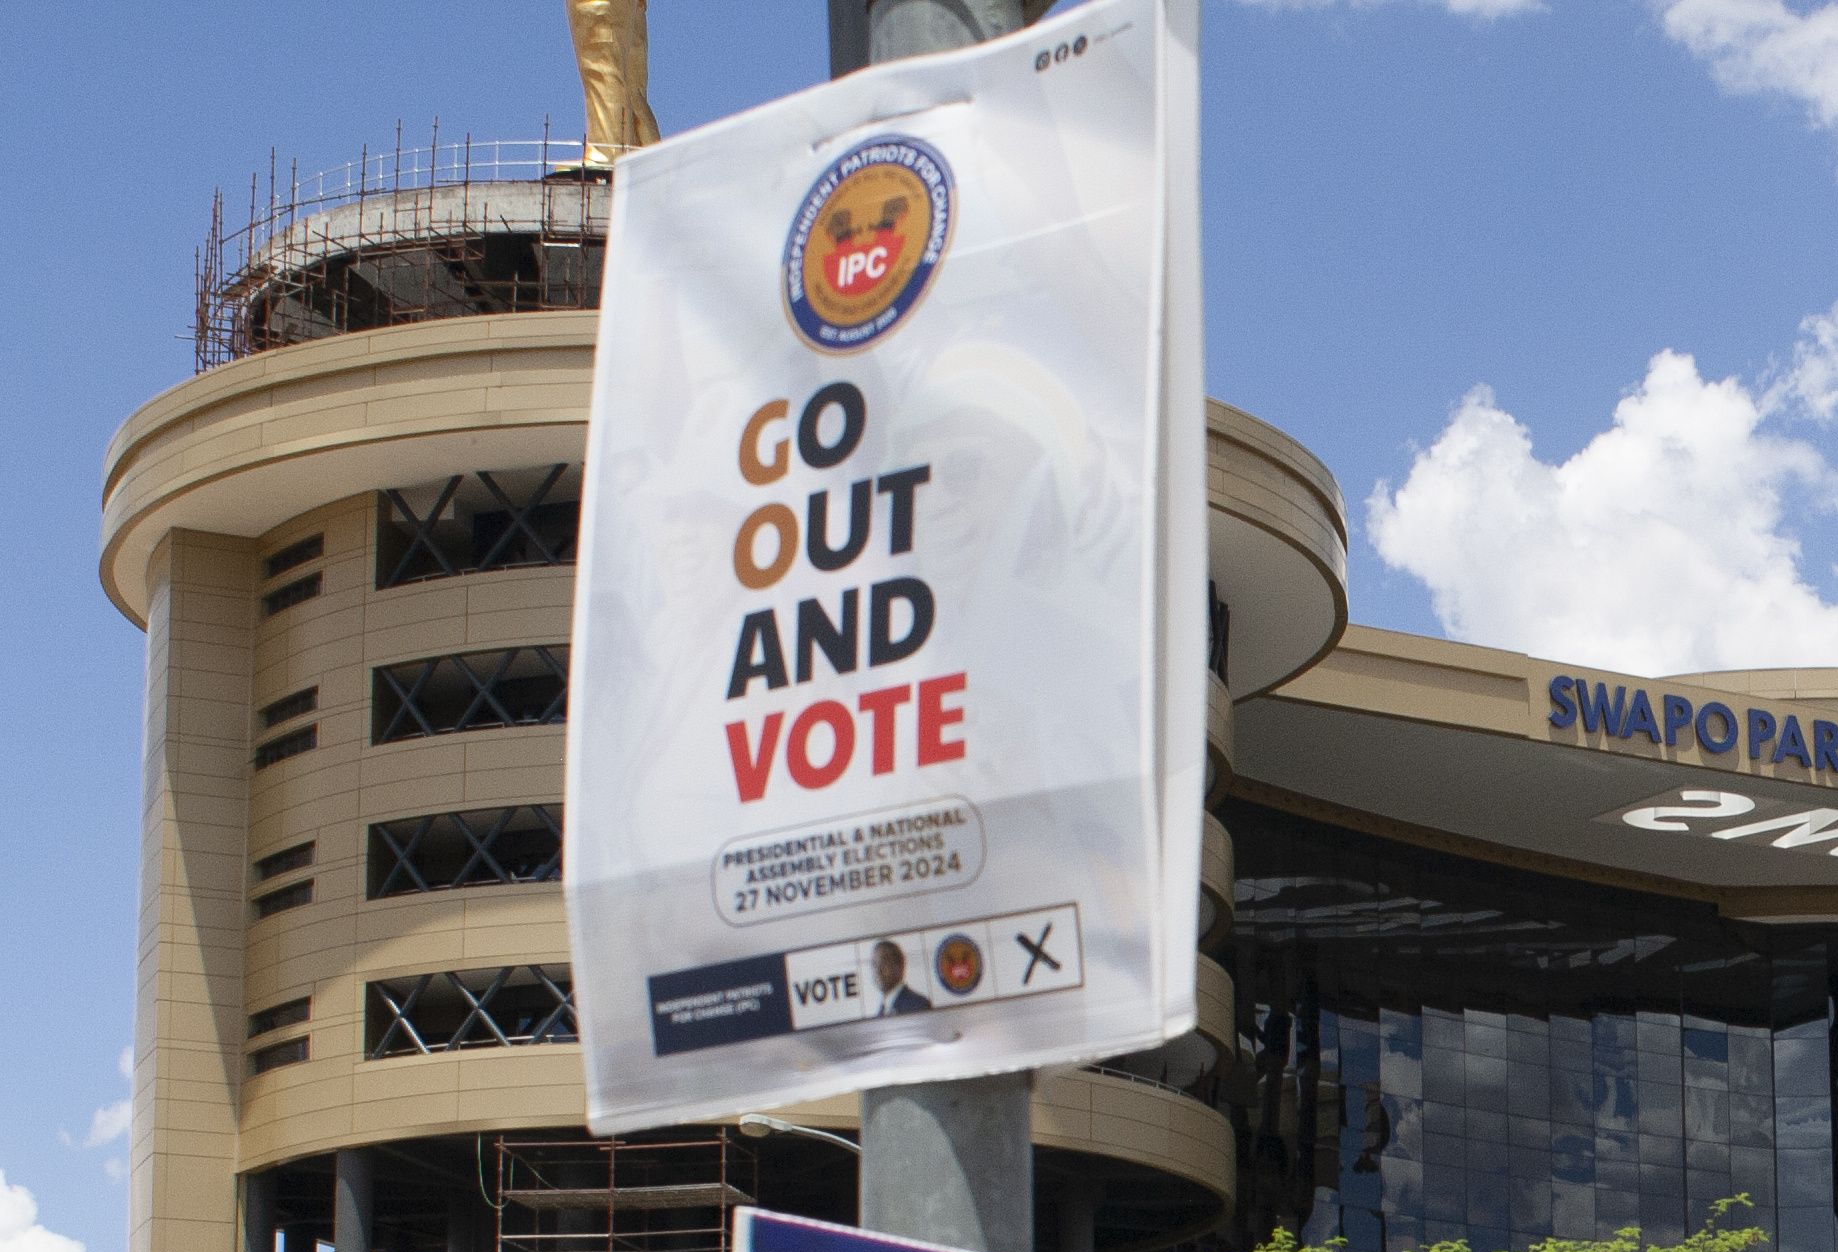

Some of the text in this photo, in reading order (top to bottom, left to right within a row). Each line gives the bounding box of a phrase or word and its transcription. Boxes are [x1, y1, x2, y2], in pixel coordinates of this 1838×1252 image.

[840, 144, 918, 177] PATRIOTS
[913, 155, 943, 190] FOR
[922, 184, 948, 264] CHANGE
[837, 246, 888, 288] IPC
[738, 381, 868, 487] GO
[732, 464, 931, 591] OUT
[725, 574, 936, 701] AND
[724, 671, 968, 805] VOTE
[1549, 675, 1738, 754] SWAPO
[722, 808, 967, 869] PRESIDENTIAL & NATIONAL
[745, 832, 945, 884] ASSEMBLY ELECTIONS
[734, 852, 962, 913] 27 NOVEMBER 2024
[793, 974, 859, 1006] VOTE
